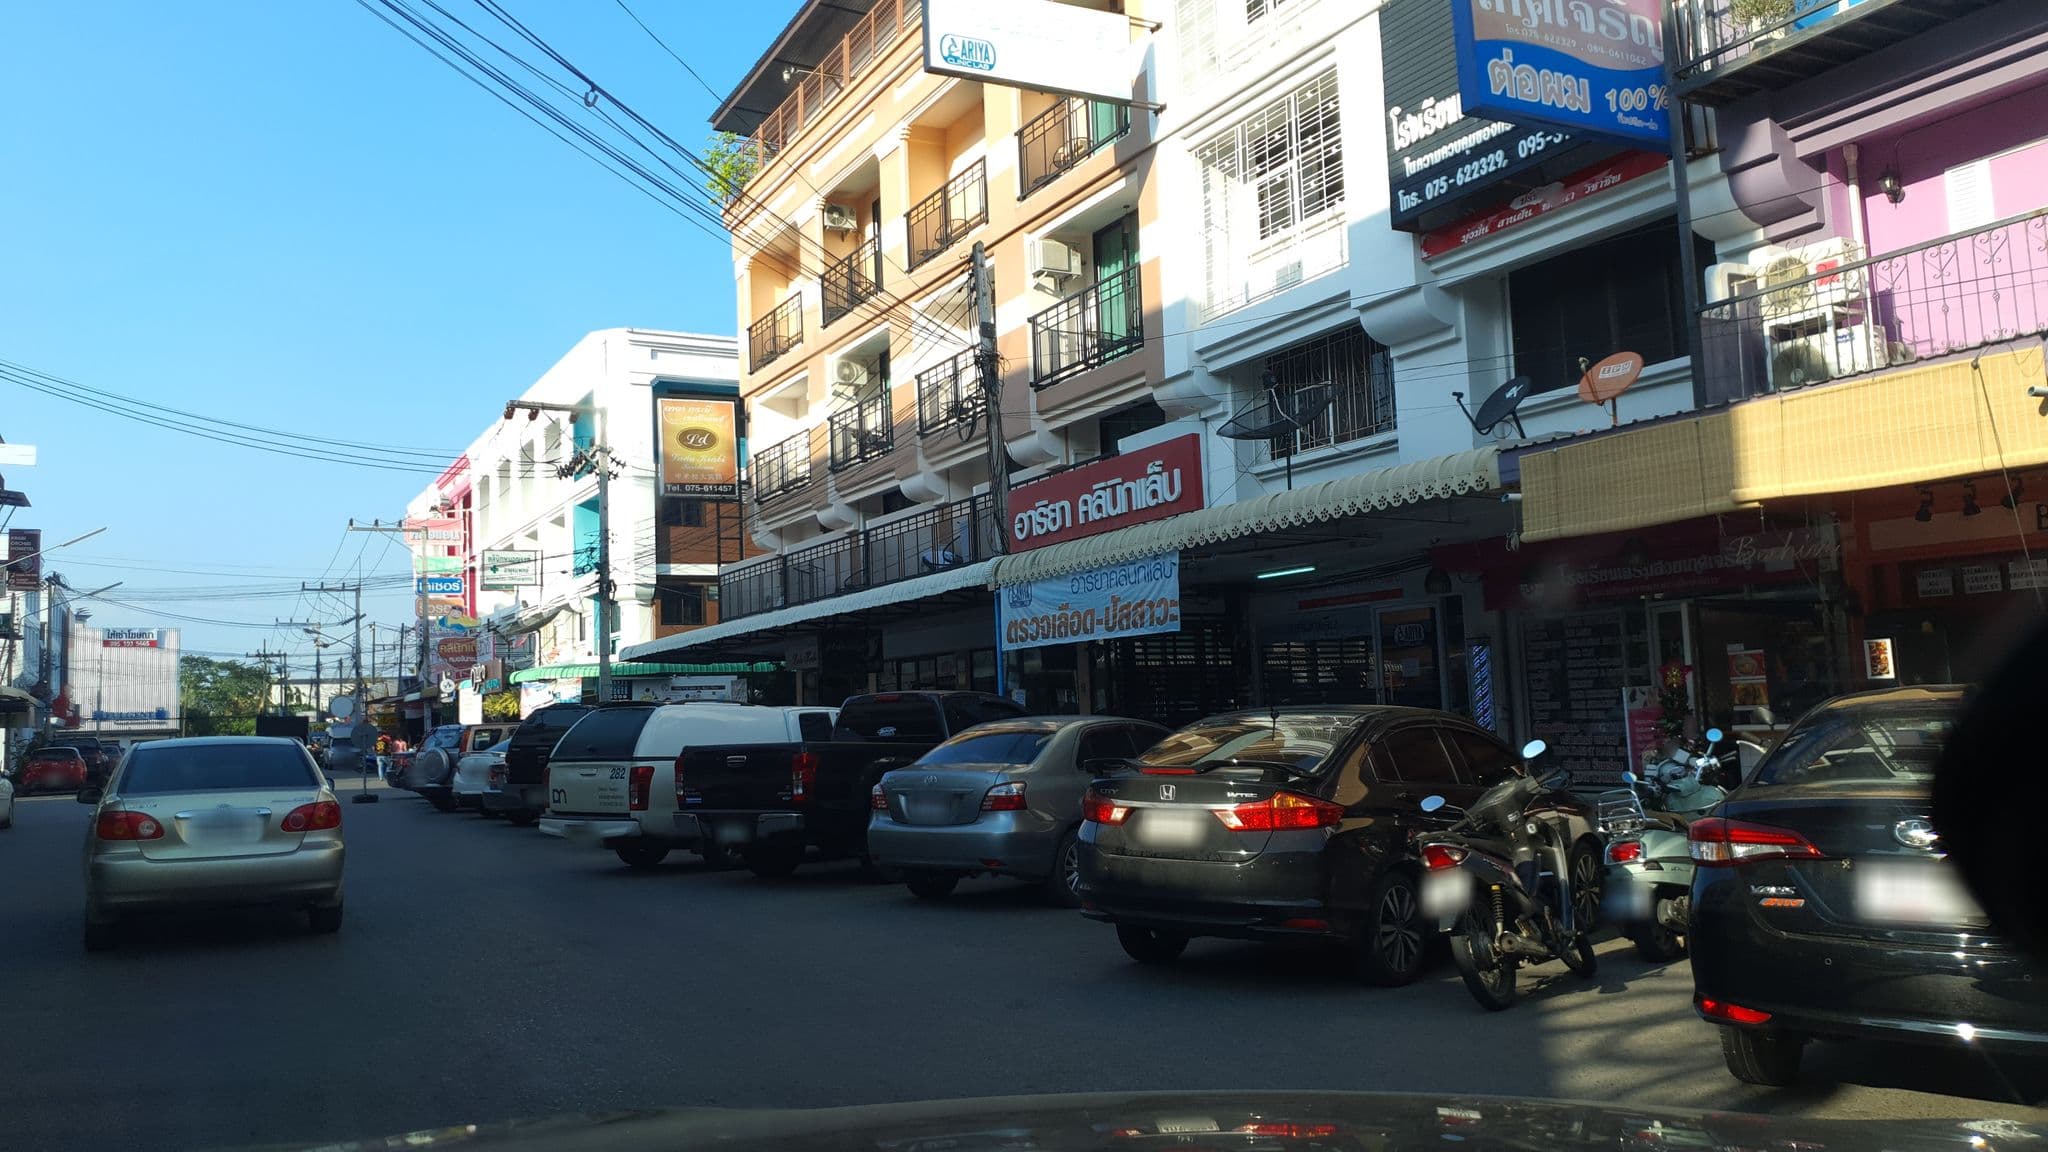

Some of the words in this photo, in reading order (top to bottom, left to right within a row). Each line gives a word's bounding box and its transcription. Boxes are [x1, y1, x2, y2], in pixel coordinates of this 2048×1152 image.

[947, 57, 973, 67] CLINIC
[973, 60, 990, 70] LAB
[961, 39, 991, 63] ARIYA
[1487, 47, 1591, 114] ต่อผม
[1604, 84, 1671, 114] 100%
[1397, 188, 1423, 212] โทร.
[1425, 149, 1509, 201] 075-622329,
[666, 484, 682, 492] Tel.
[685, 484, 733, 492] 075-611457
[1014, 499, 1072, 541] อาริยา
[1007, 594, 1179, 644] ตรวจเลือด-ปัสสาวะ
[609, 767, 626, 780] 282
